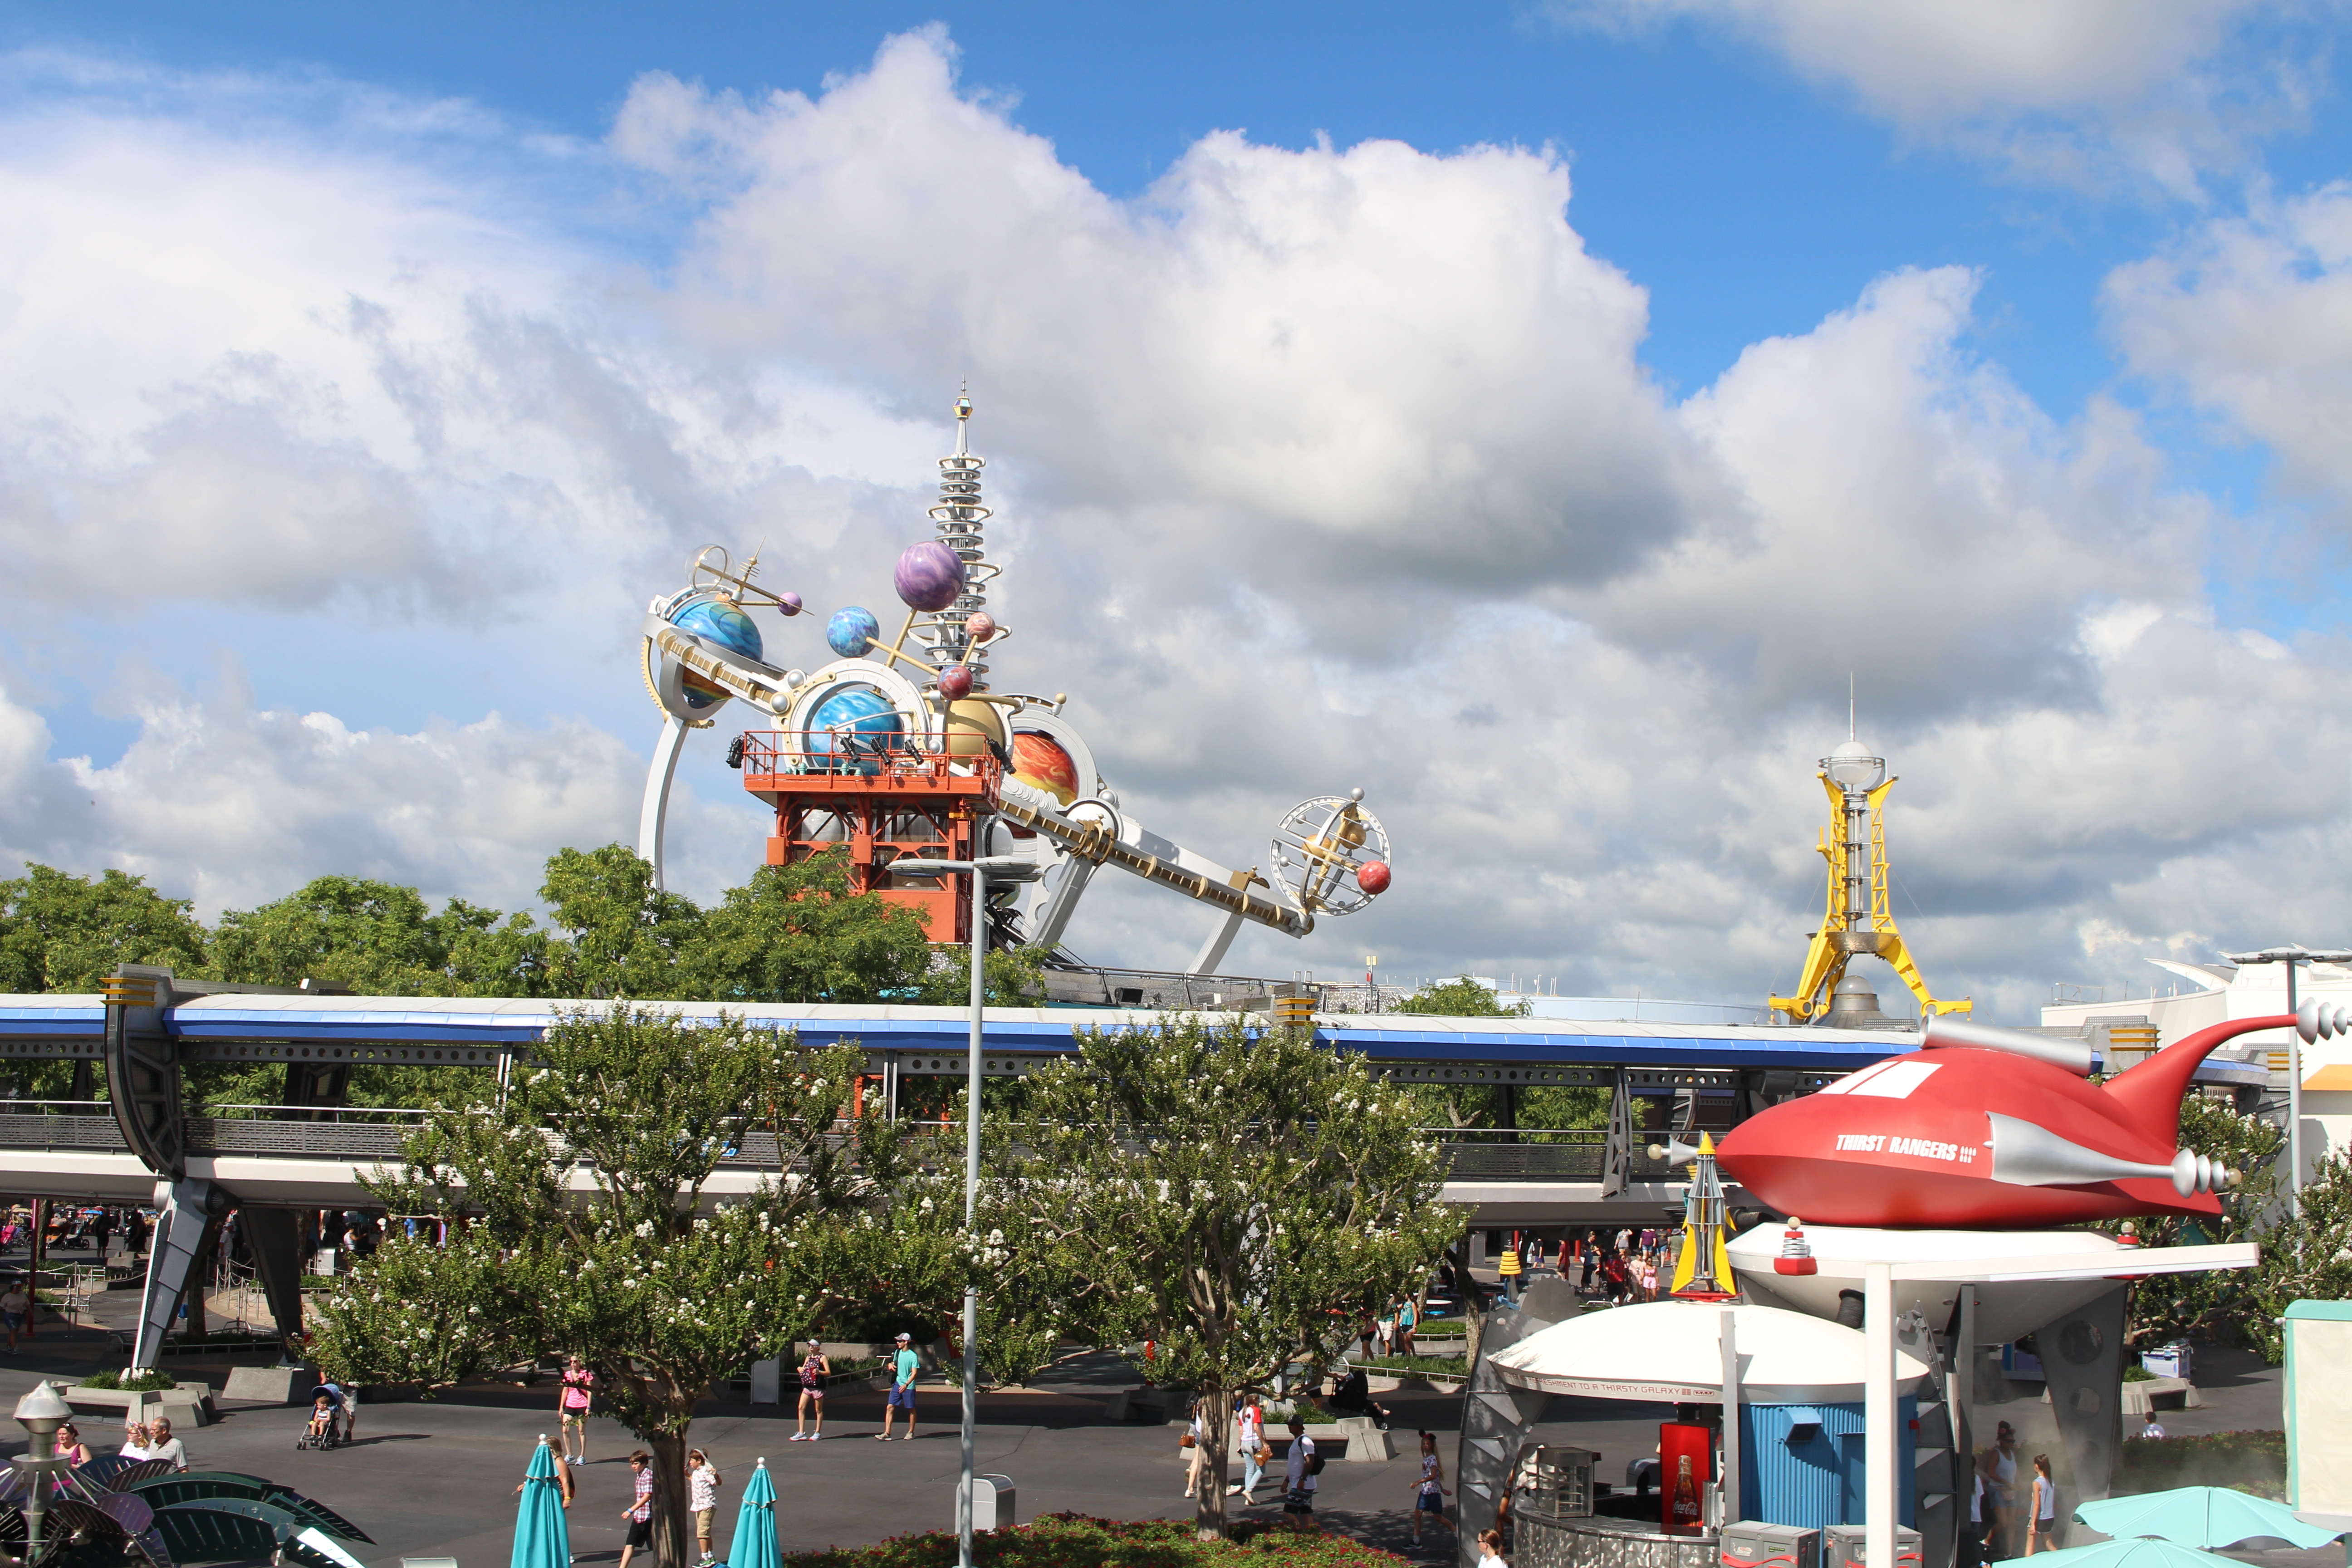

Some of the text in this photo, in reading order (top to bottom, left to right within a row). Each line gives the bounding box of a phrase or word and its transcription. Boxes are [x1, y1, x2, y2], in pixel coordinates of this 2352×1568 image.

[1836, 1135, 1958, 1161] THIRST RANGERS
[1528, 1376, 1577, 1389] REFRESHMENT
[1641, 1386, 1681, 1395] GALAXY
[1673, 1500, 1697, 1515] Coca-Cola
